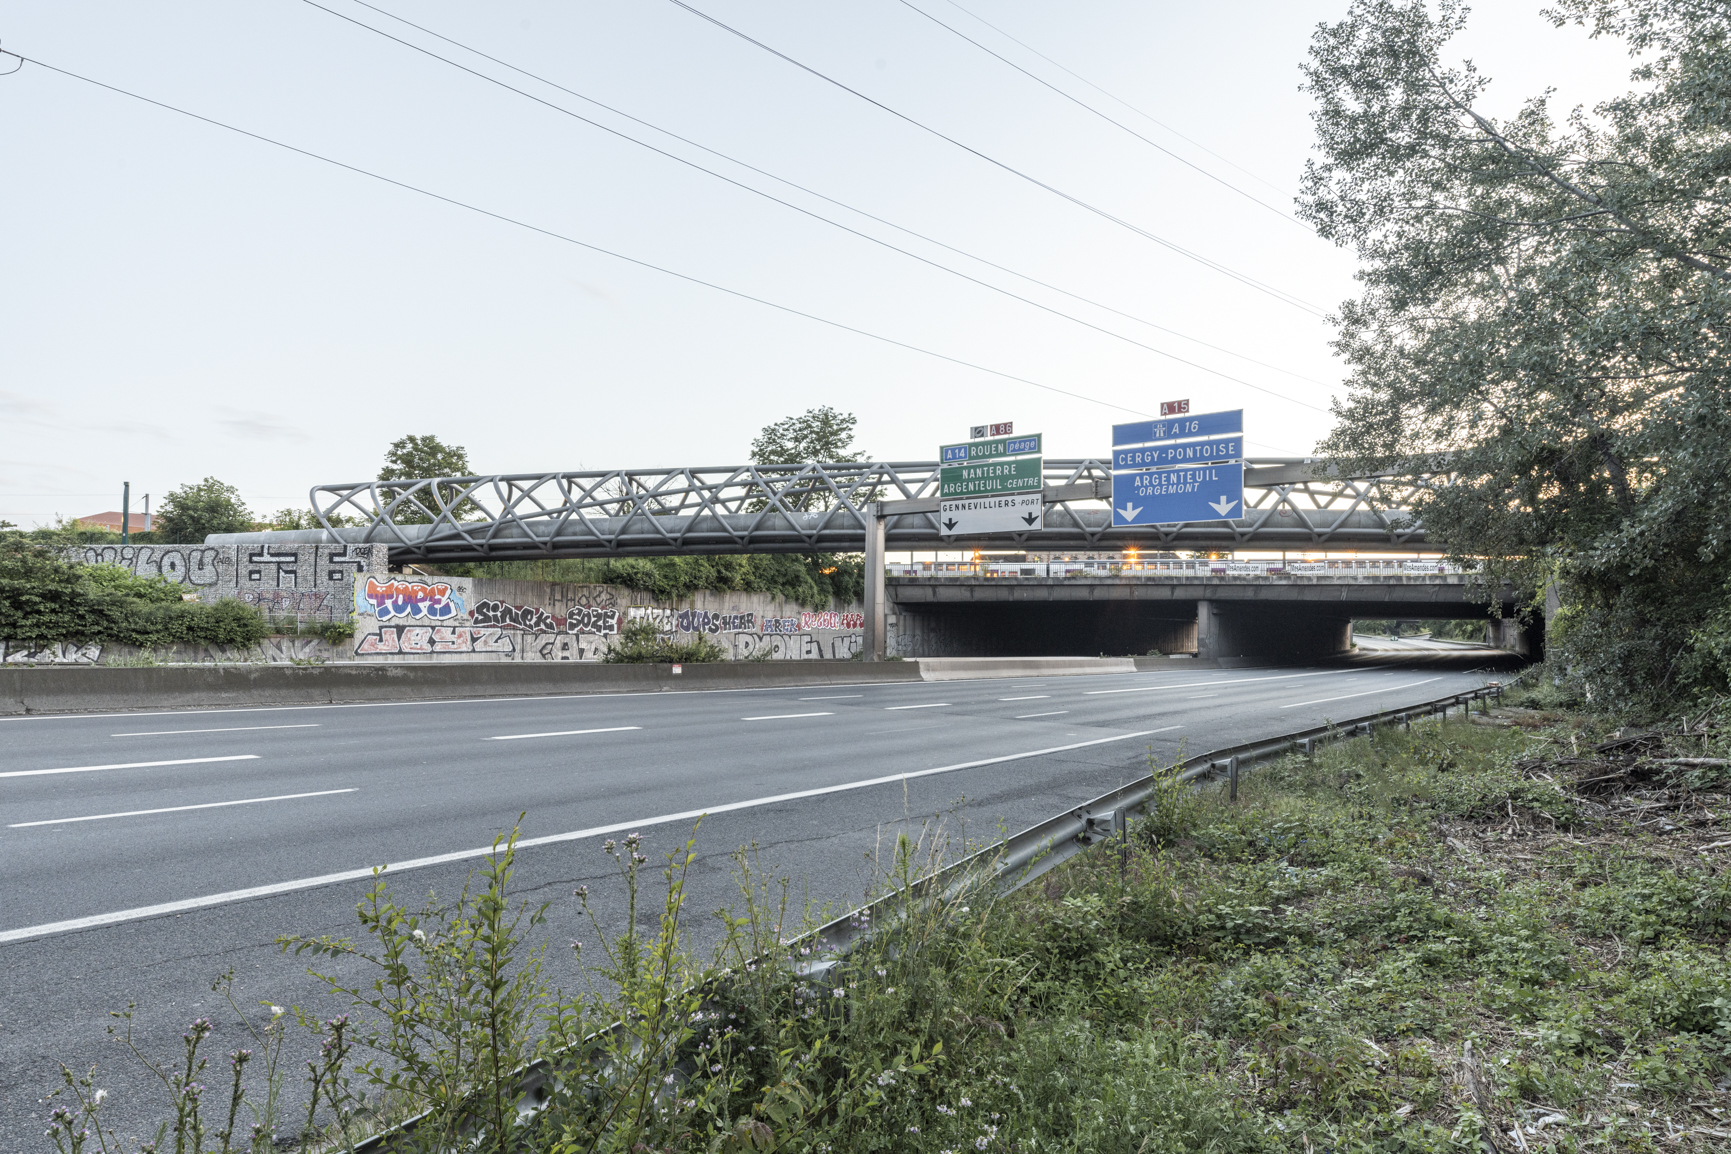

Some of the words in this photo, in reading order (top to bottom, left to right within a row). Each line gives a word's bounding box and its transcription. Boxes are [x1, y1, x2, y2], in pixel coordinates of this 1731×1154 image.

[1162, 404, 1168, 414] A
[1173, 401, 1188, 412] 15
[990, 426, 996, 435] A
[1000, 423, 1012, 434] 86
[1171, 423, 1180, 434] A
[1184, 420, 1199, 433] 16
[946, 450, 952, 460] A
[954, 448, 965, 458] 14
[970, 443, 1004, 456] ROUEN
[1008, 440, 1036, 452] péage
[1118, 442, 1236, 465] CERGY-PONTOISE
[962, 464, 1017, 480] NANTERRE
[1134, 469, 1218, 487] ARGENTEUIL
[944, 478, 1002, 494] ARGENTEUIL
[942, 498, 1016, 512] GENNEVILLIERS
